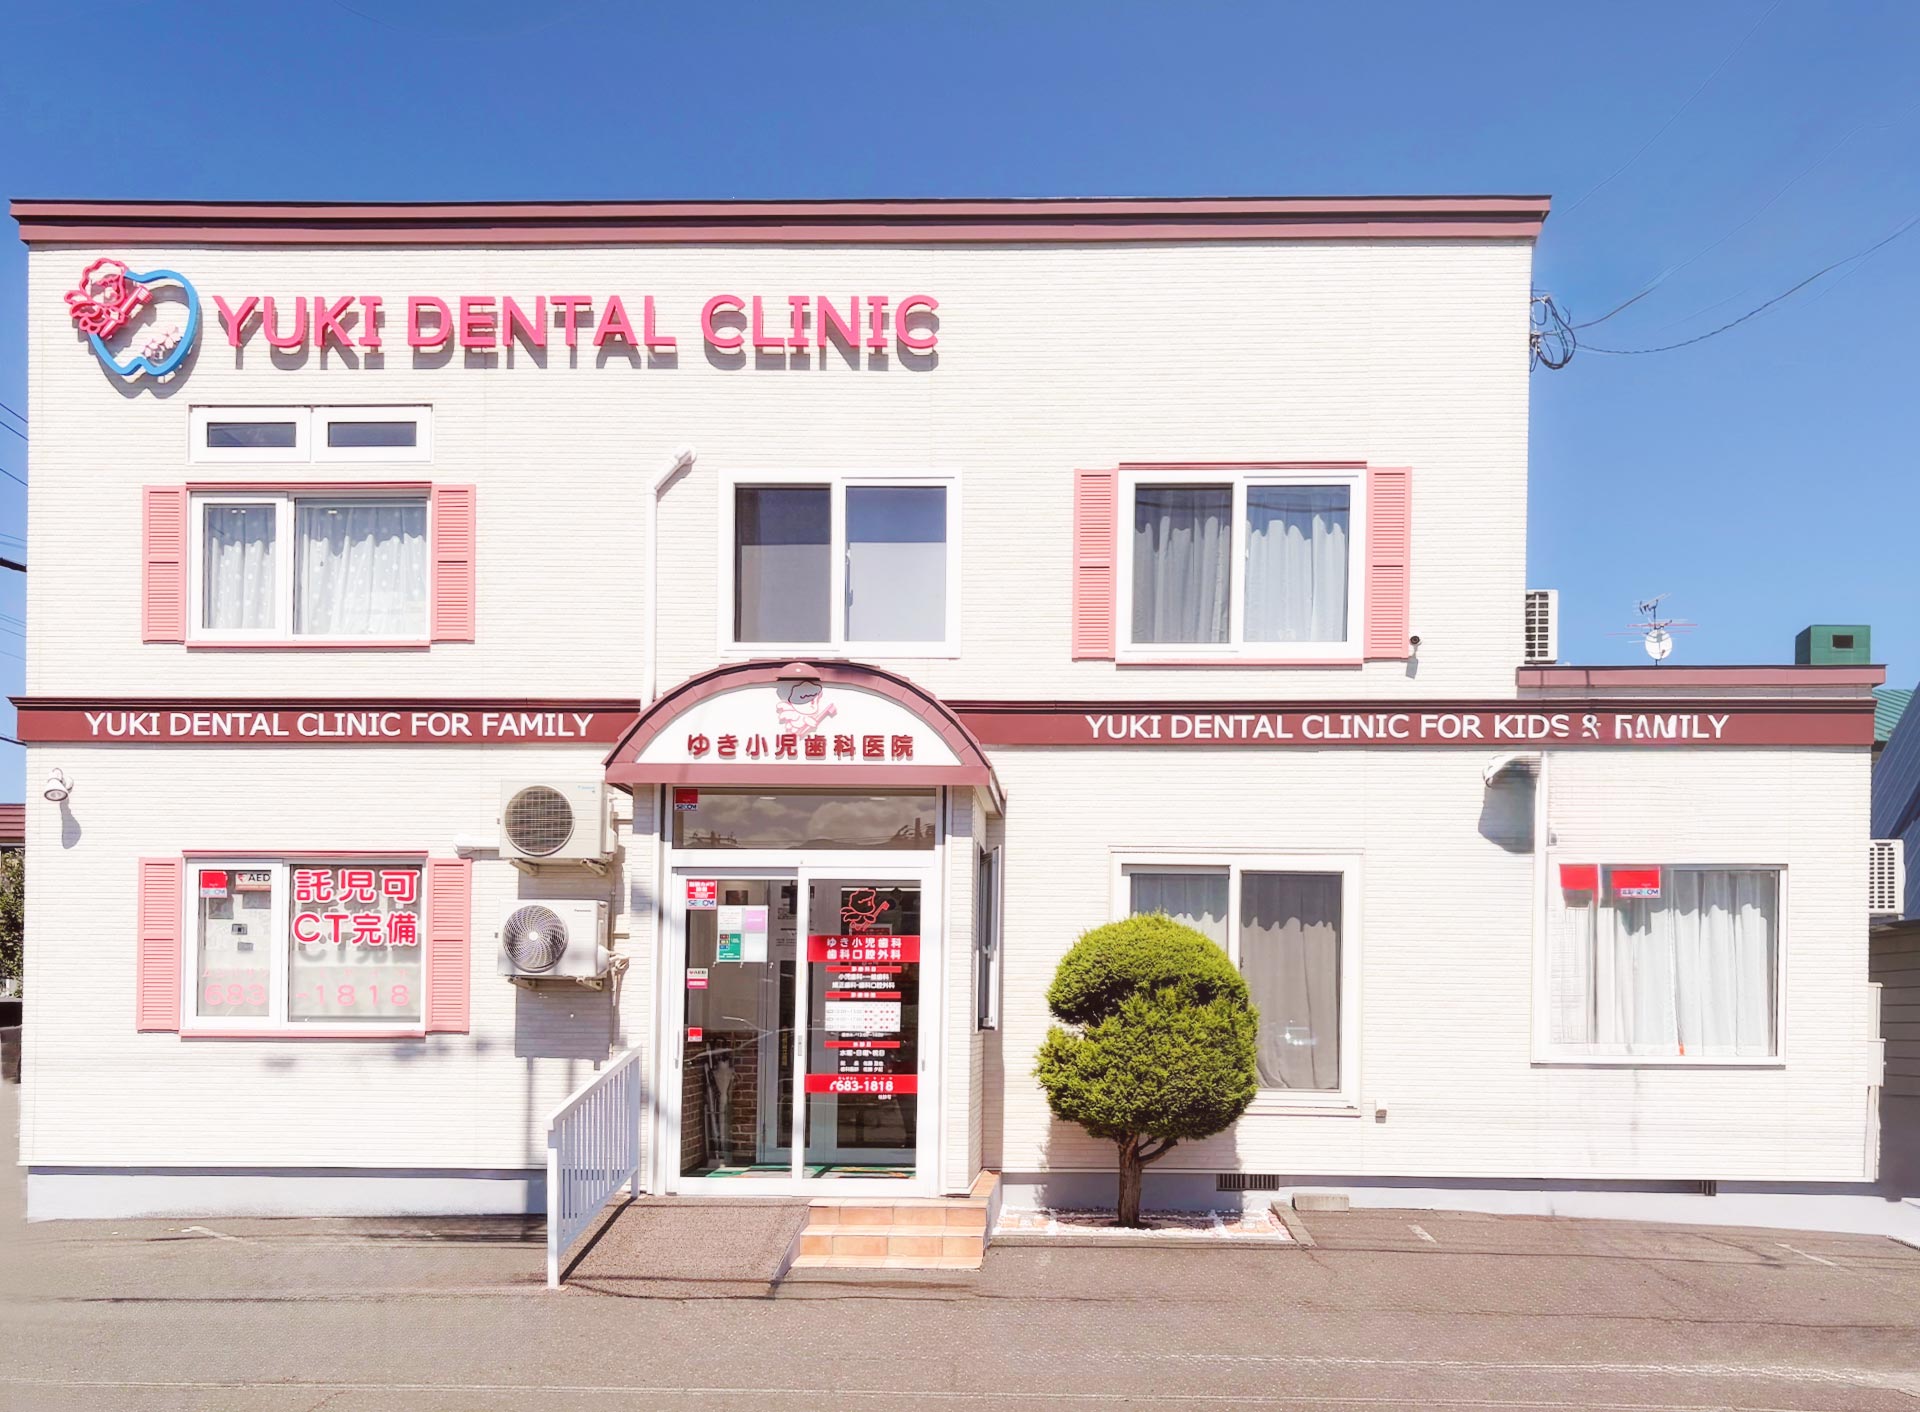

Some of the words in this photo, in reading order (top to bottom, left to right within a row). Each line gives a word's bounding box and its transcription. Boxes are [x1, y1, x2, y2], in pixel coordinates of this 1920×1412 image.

[213, 295, 383, 349] YUKI
[407, 295, 677, 349] DENTAL
[700, 294, 938, 350] CLINIC
[85, 712, 160, 737] YUKI
[169, 712, 290, 737] DENTAL
[297, 712, 400, 737] CLINIC
[411, 712, 473, 737] FOR
[482, 712, 594, 737] FAMILY
[1085, 715, 1162, 739] YUKI
[1171, 714, 1294, 739] DENTAL
[1301, 714, 1409, 739] CLINIC
[1420, 714, 1484, 739] FOR
[1494, 714, 1570, 739] KIDS
[687, 733, 914, 758] ゆき小児歯科医院
[248, 873, 271, 882] AED
[293, 868, 421, 905] 託児可
[292, 912, 419, 947] CT完備
[826, 937, 902, 949] ゆき小児歯科
[826, 949, 902, 960] 歯科口腔外科
[204, 983, 267, 1007] 683
[836, 1080, 894, 1092] 683-1818
